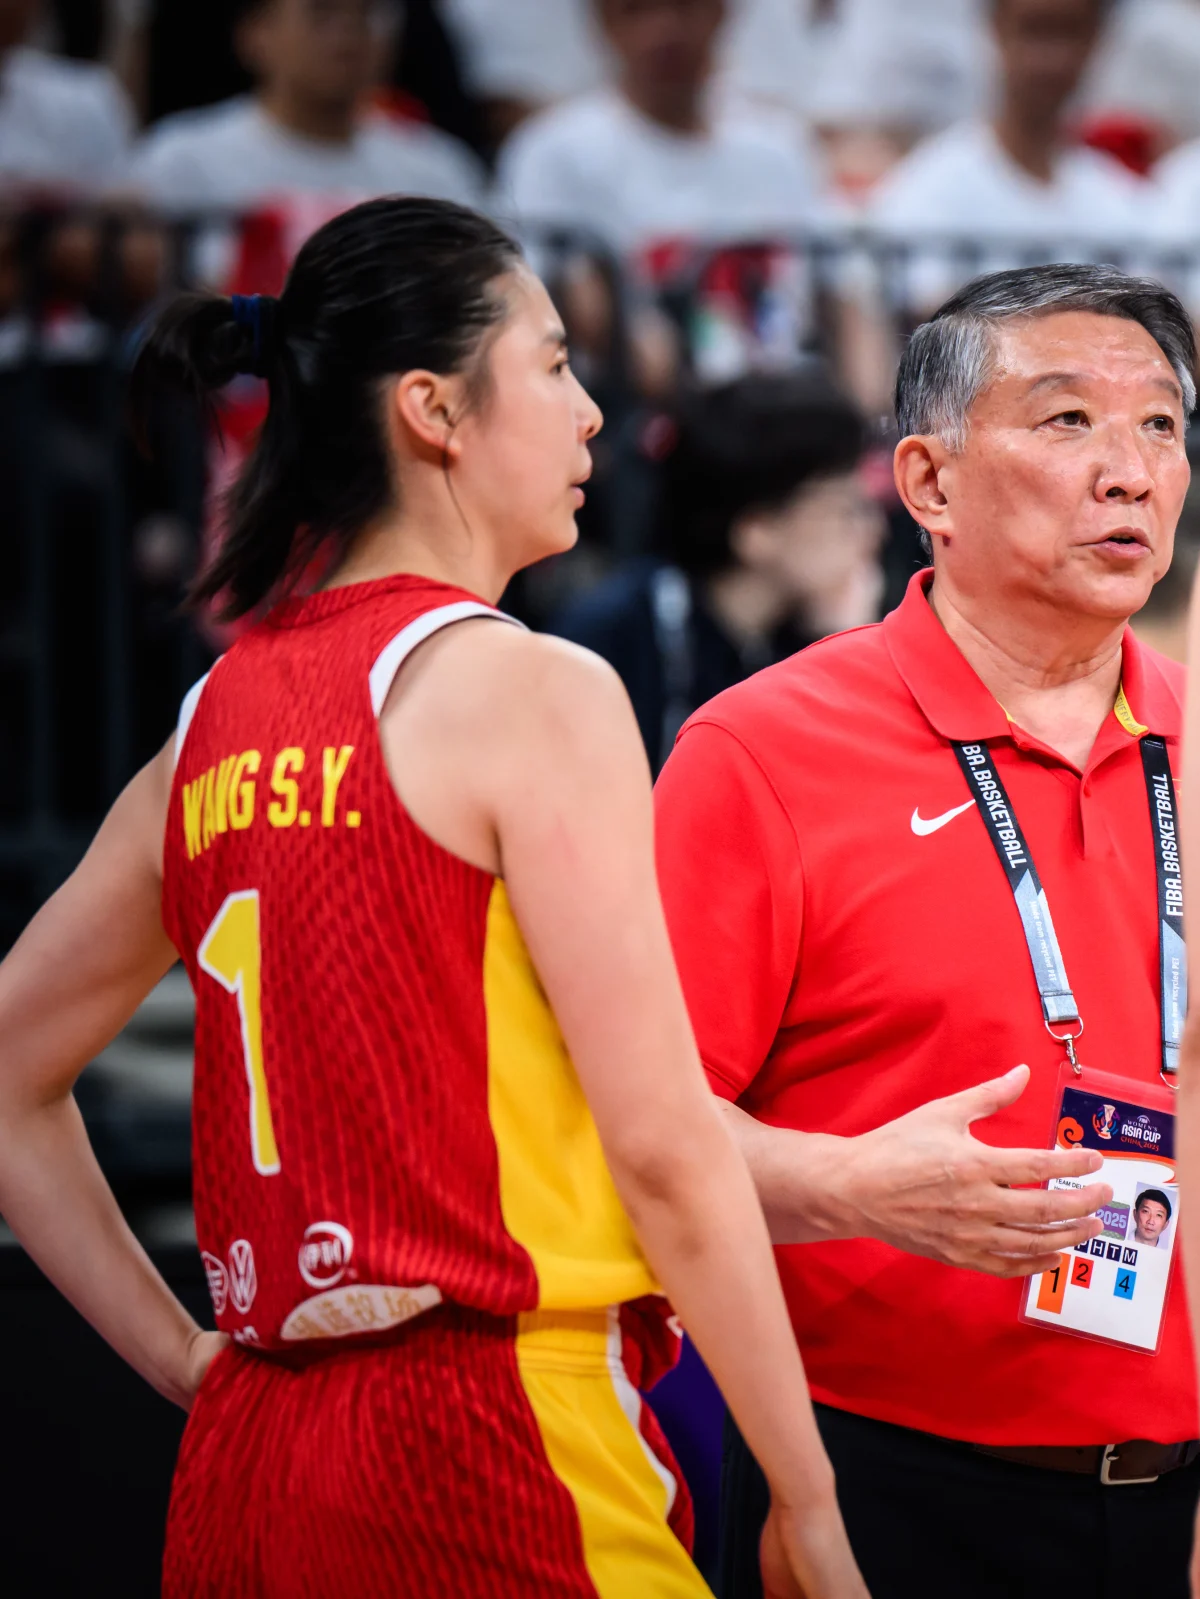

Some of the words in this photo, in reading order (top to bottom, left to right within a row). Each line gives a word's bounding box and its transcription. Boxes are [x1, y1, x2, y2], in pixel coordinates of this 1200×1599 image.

[182, 749, 262, 862] WANG
[267, 745, 361, 828] S.Y.
[197, 888, 280, 1177] 1
[1121, 1124, 1142, 1139] ASIA
[1143, 1129, 1161, 1143] CUP
[1127, 1119, 1158, 1132] WOMEN'S
[1143, 1141, 1159, 1152] 2025
[1055, 1178, 1071, 1187] TEAM
[1096, 1208, 1127, 1229] 2025
[1092, 1239, 1104, 1255] H
[1110, 1244, 1120, 1259] T
[1123, 1248, 1136, 1264] M
[1050, 1266, 1060, 1293] 1
[1075, 1263, 1089, 1282] 2
[1118, 1274, 1130, 1293] 4
